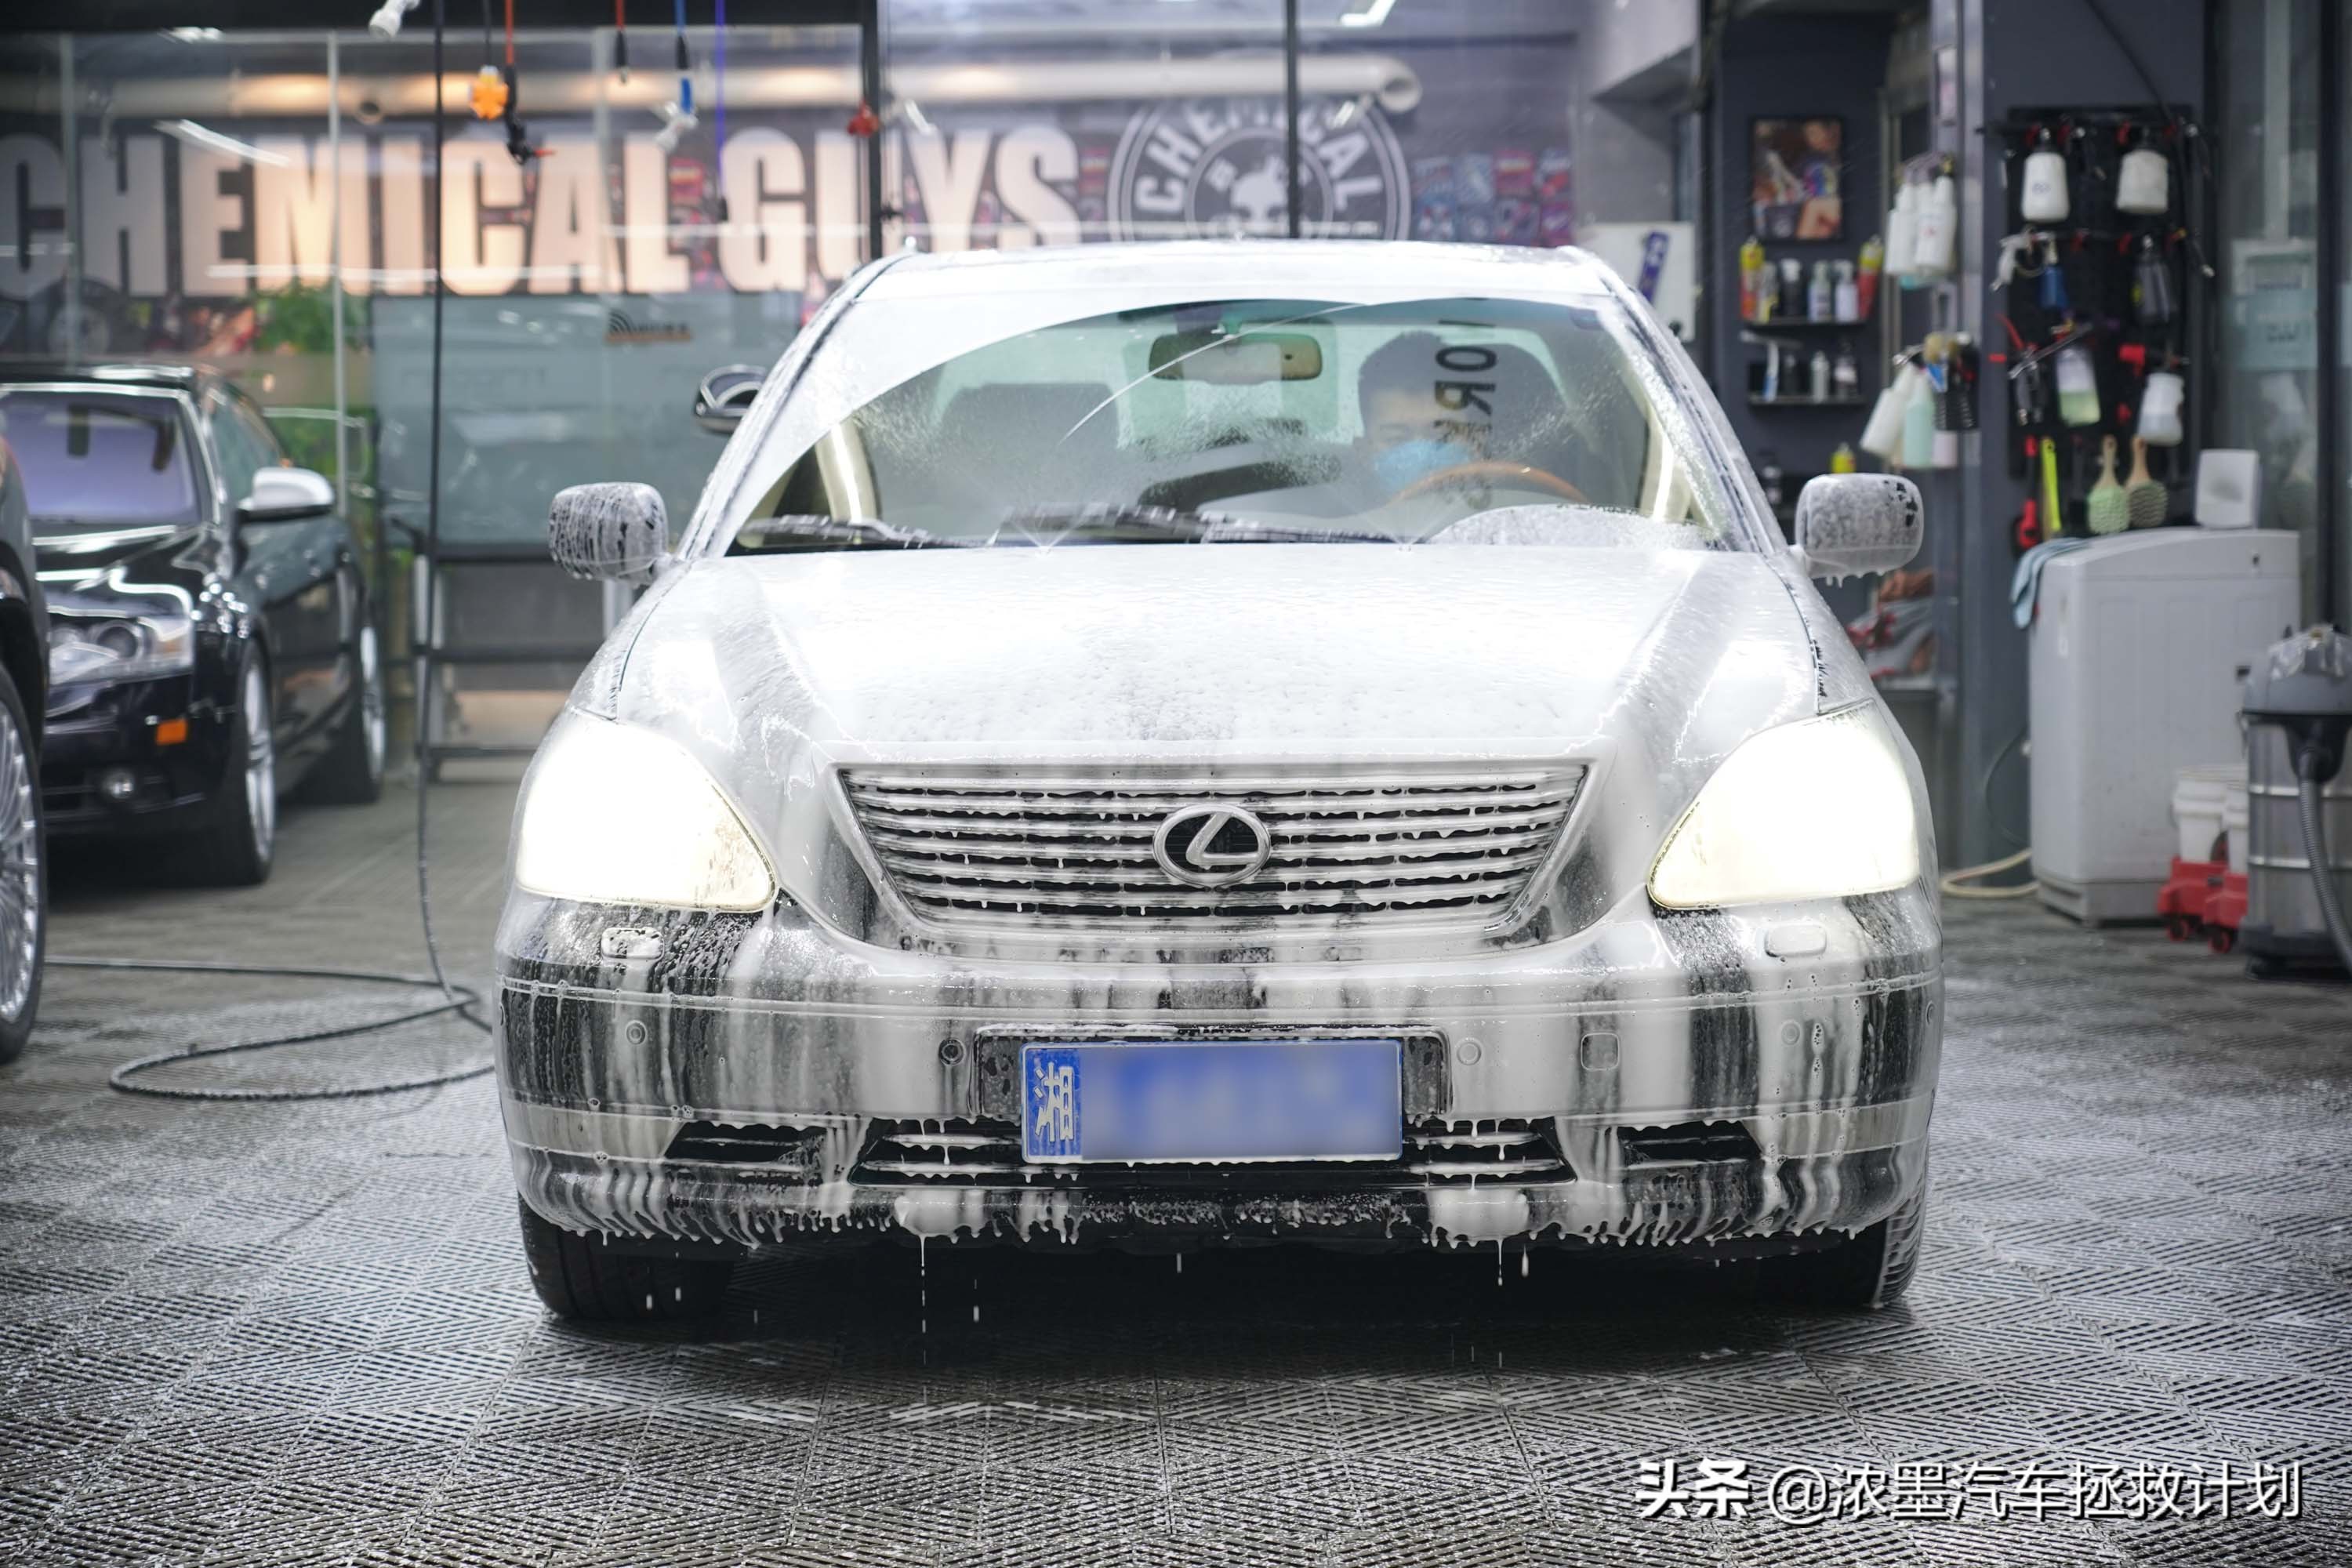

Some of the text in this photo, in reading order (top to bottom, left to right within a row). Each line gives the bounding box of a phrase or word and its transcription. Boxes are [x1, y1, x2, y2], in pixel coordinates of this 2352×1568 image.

[0, 126, 1081, 299] CHEMICAL GUYS
[1033, 1061, 1075, 1143] 湘
